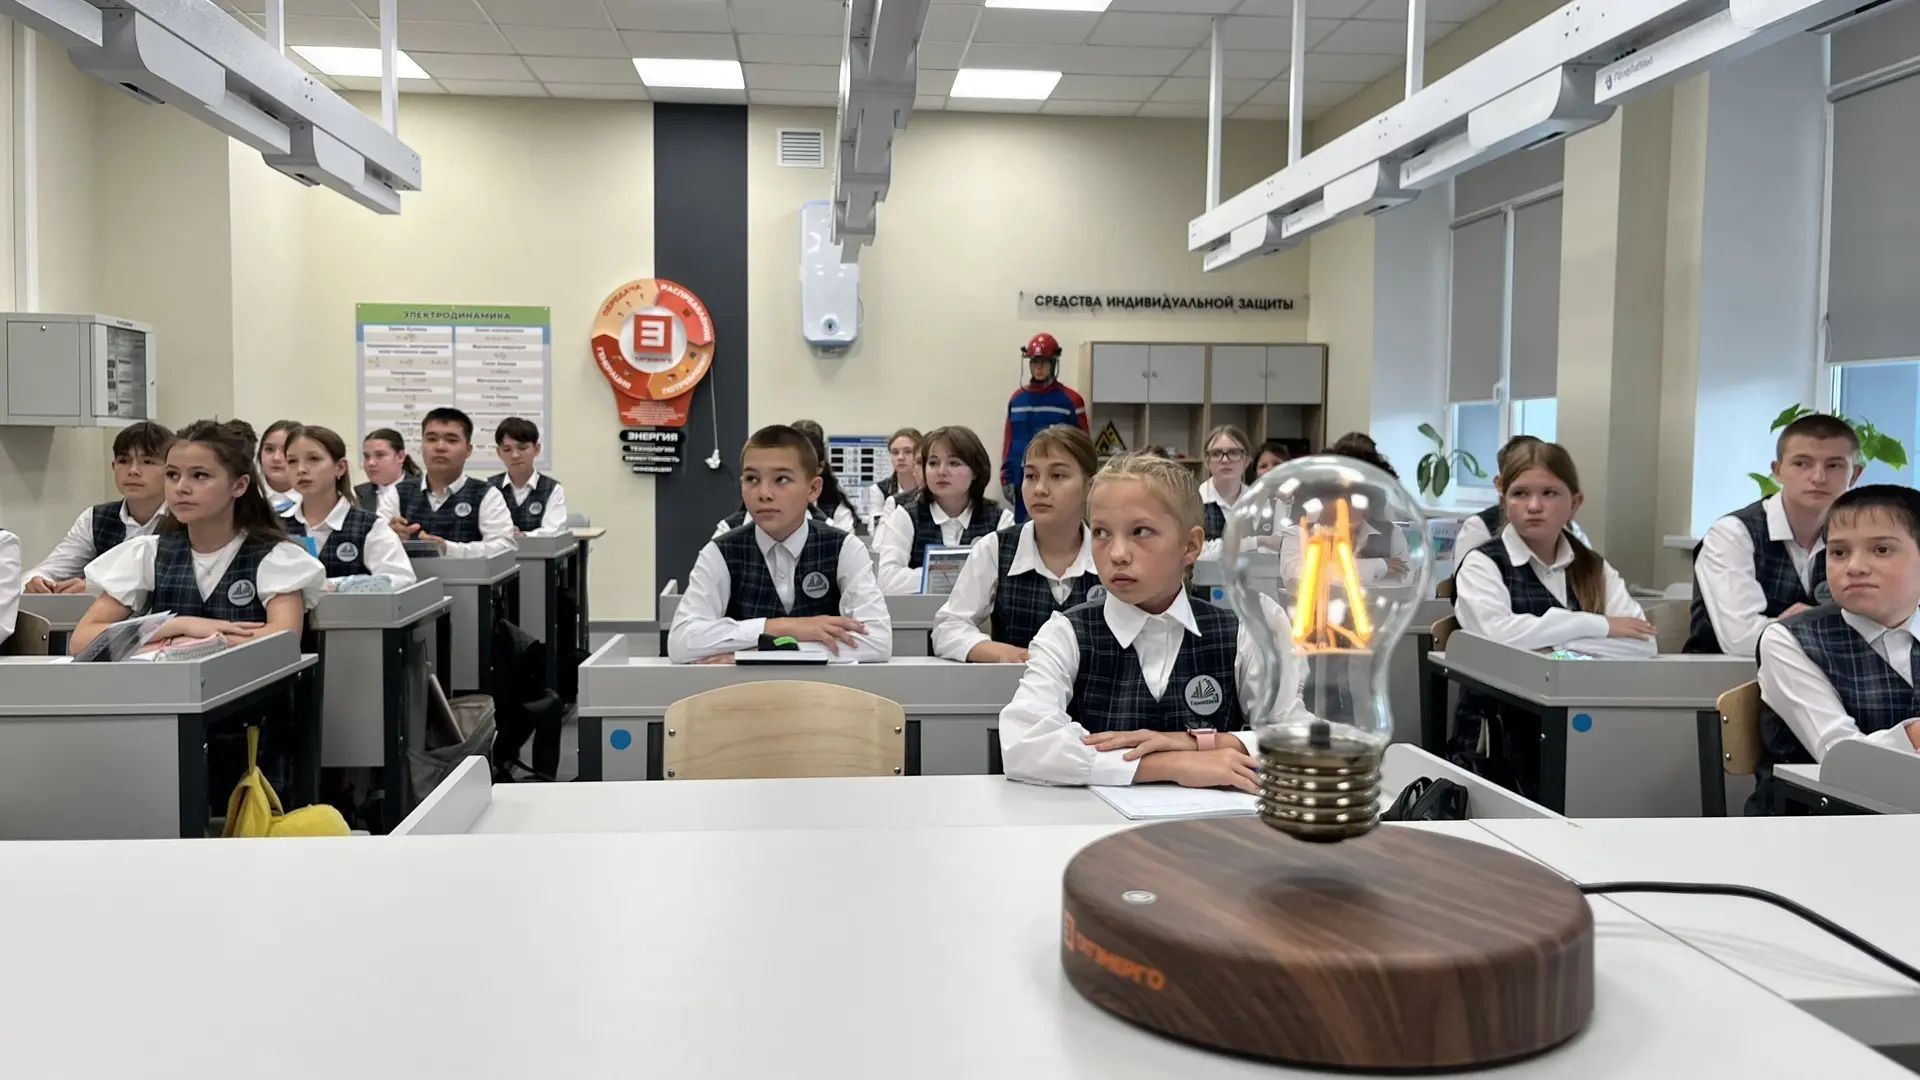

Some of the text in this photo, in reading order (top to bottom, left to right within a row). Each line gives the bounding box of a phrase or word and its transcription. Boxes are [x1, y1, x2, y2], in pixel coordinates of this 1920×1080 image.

[1034, 295, 1294, 311] СРЕДСТВА ИНДИВИДУАЛЬНОЙ ЗАЩИТЫ
[403, 311, 512, 321] ЭЛЕКТРОДИНАМИКА
[597, 346, 631, 390] ГЕНЕРАЦИЯ
[627, 431, 679, 442] ЭНЕРГИЯ
